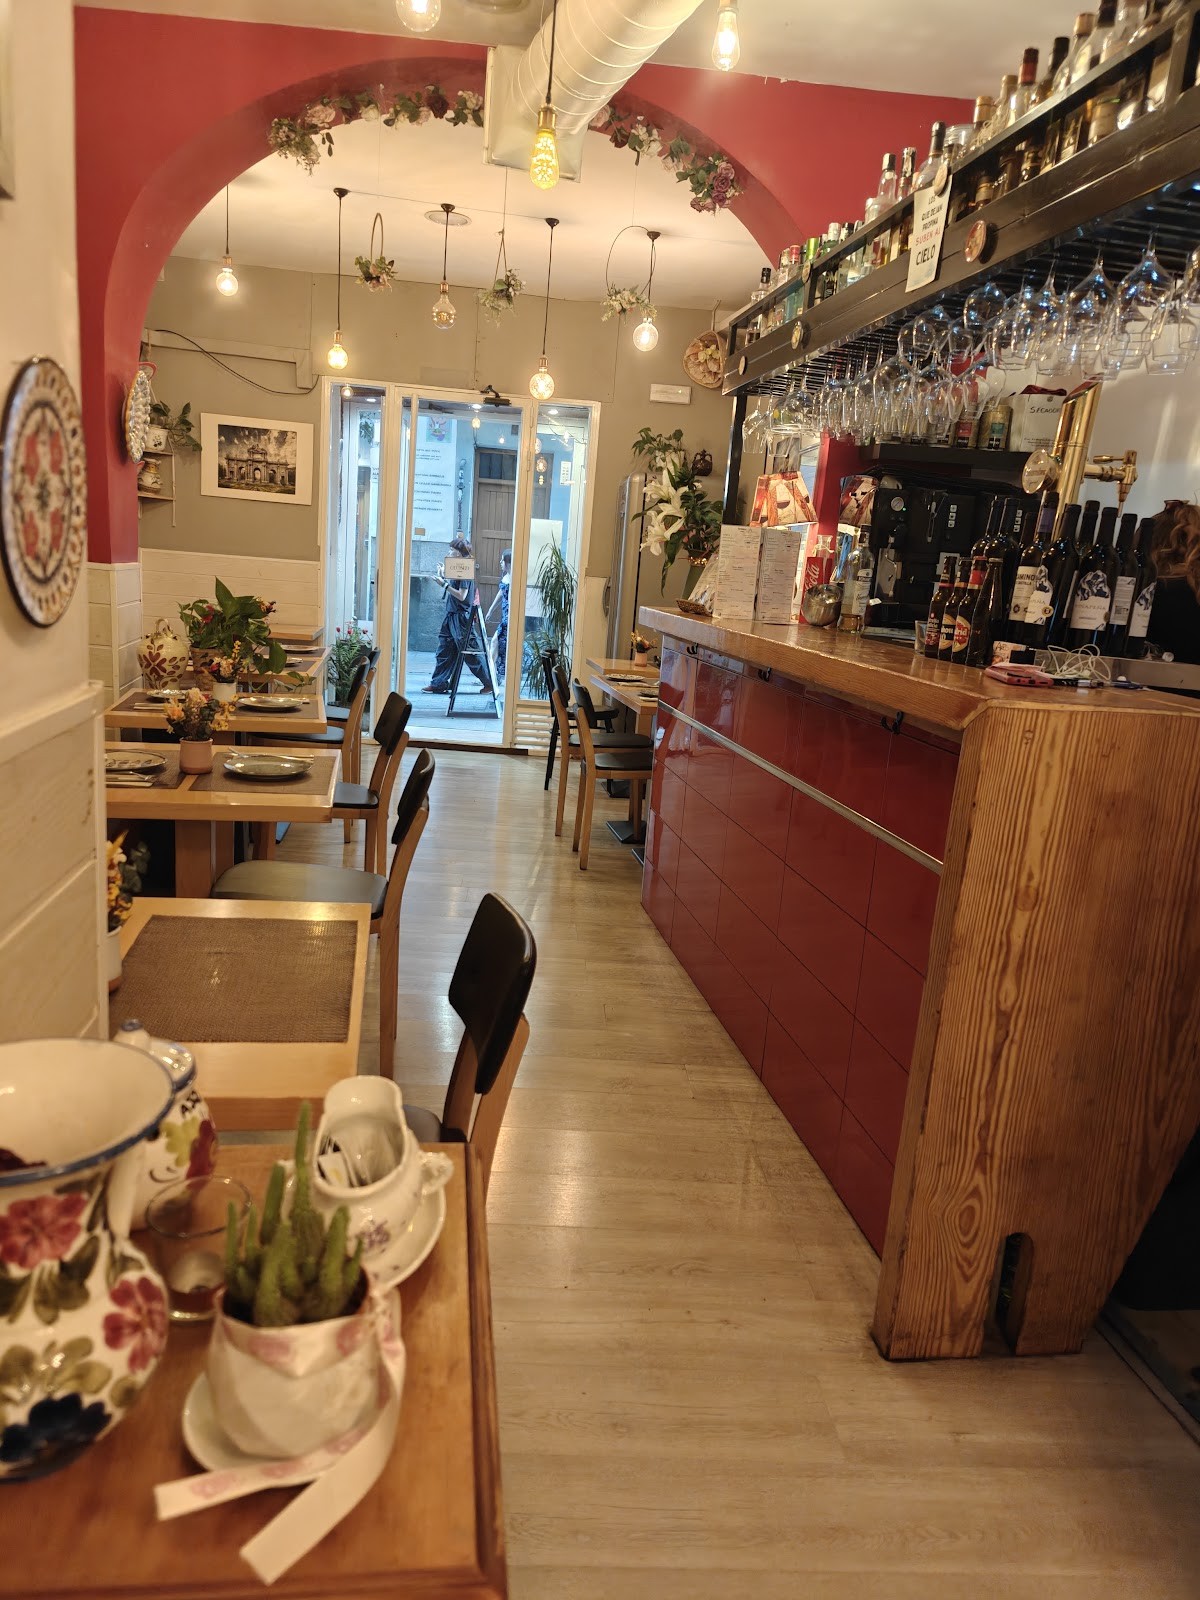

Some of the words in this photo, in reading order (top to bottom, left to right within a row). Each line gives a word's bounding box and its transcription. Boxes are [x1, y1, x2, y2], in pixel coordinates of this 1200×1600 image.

[921, 210, 930, 221] QUE
[922, 217, 938, 231] PROPINA
[915, 231, 933, 246] SUBEN
[916, 244, 936, 266] CIELO
